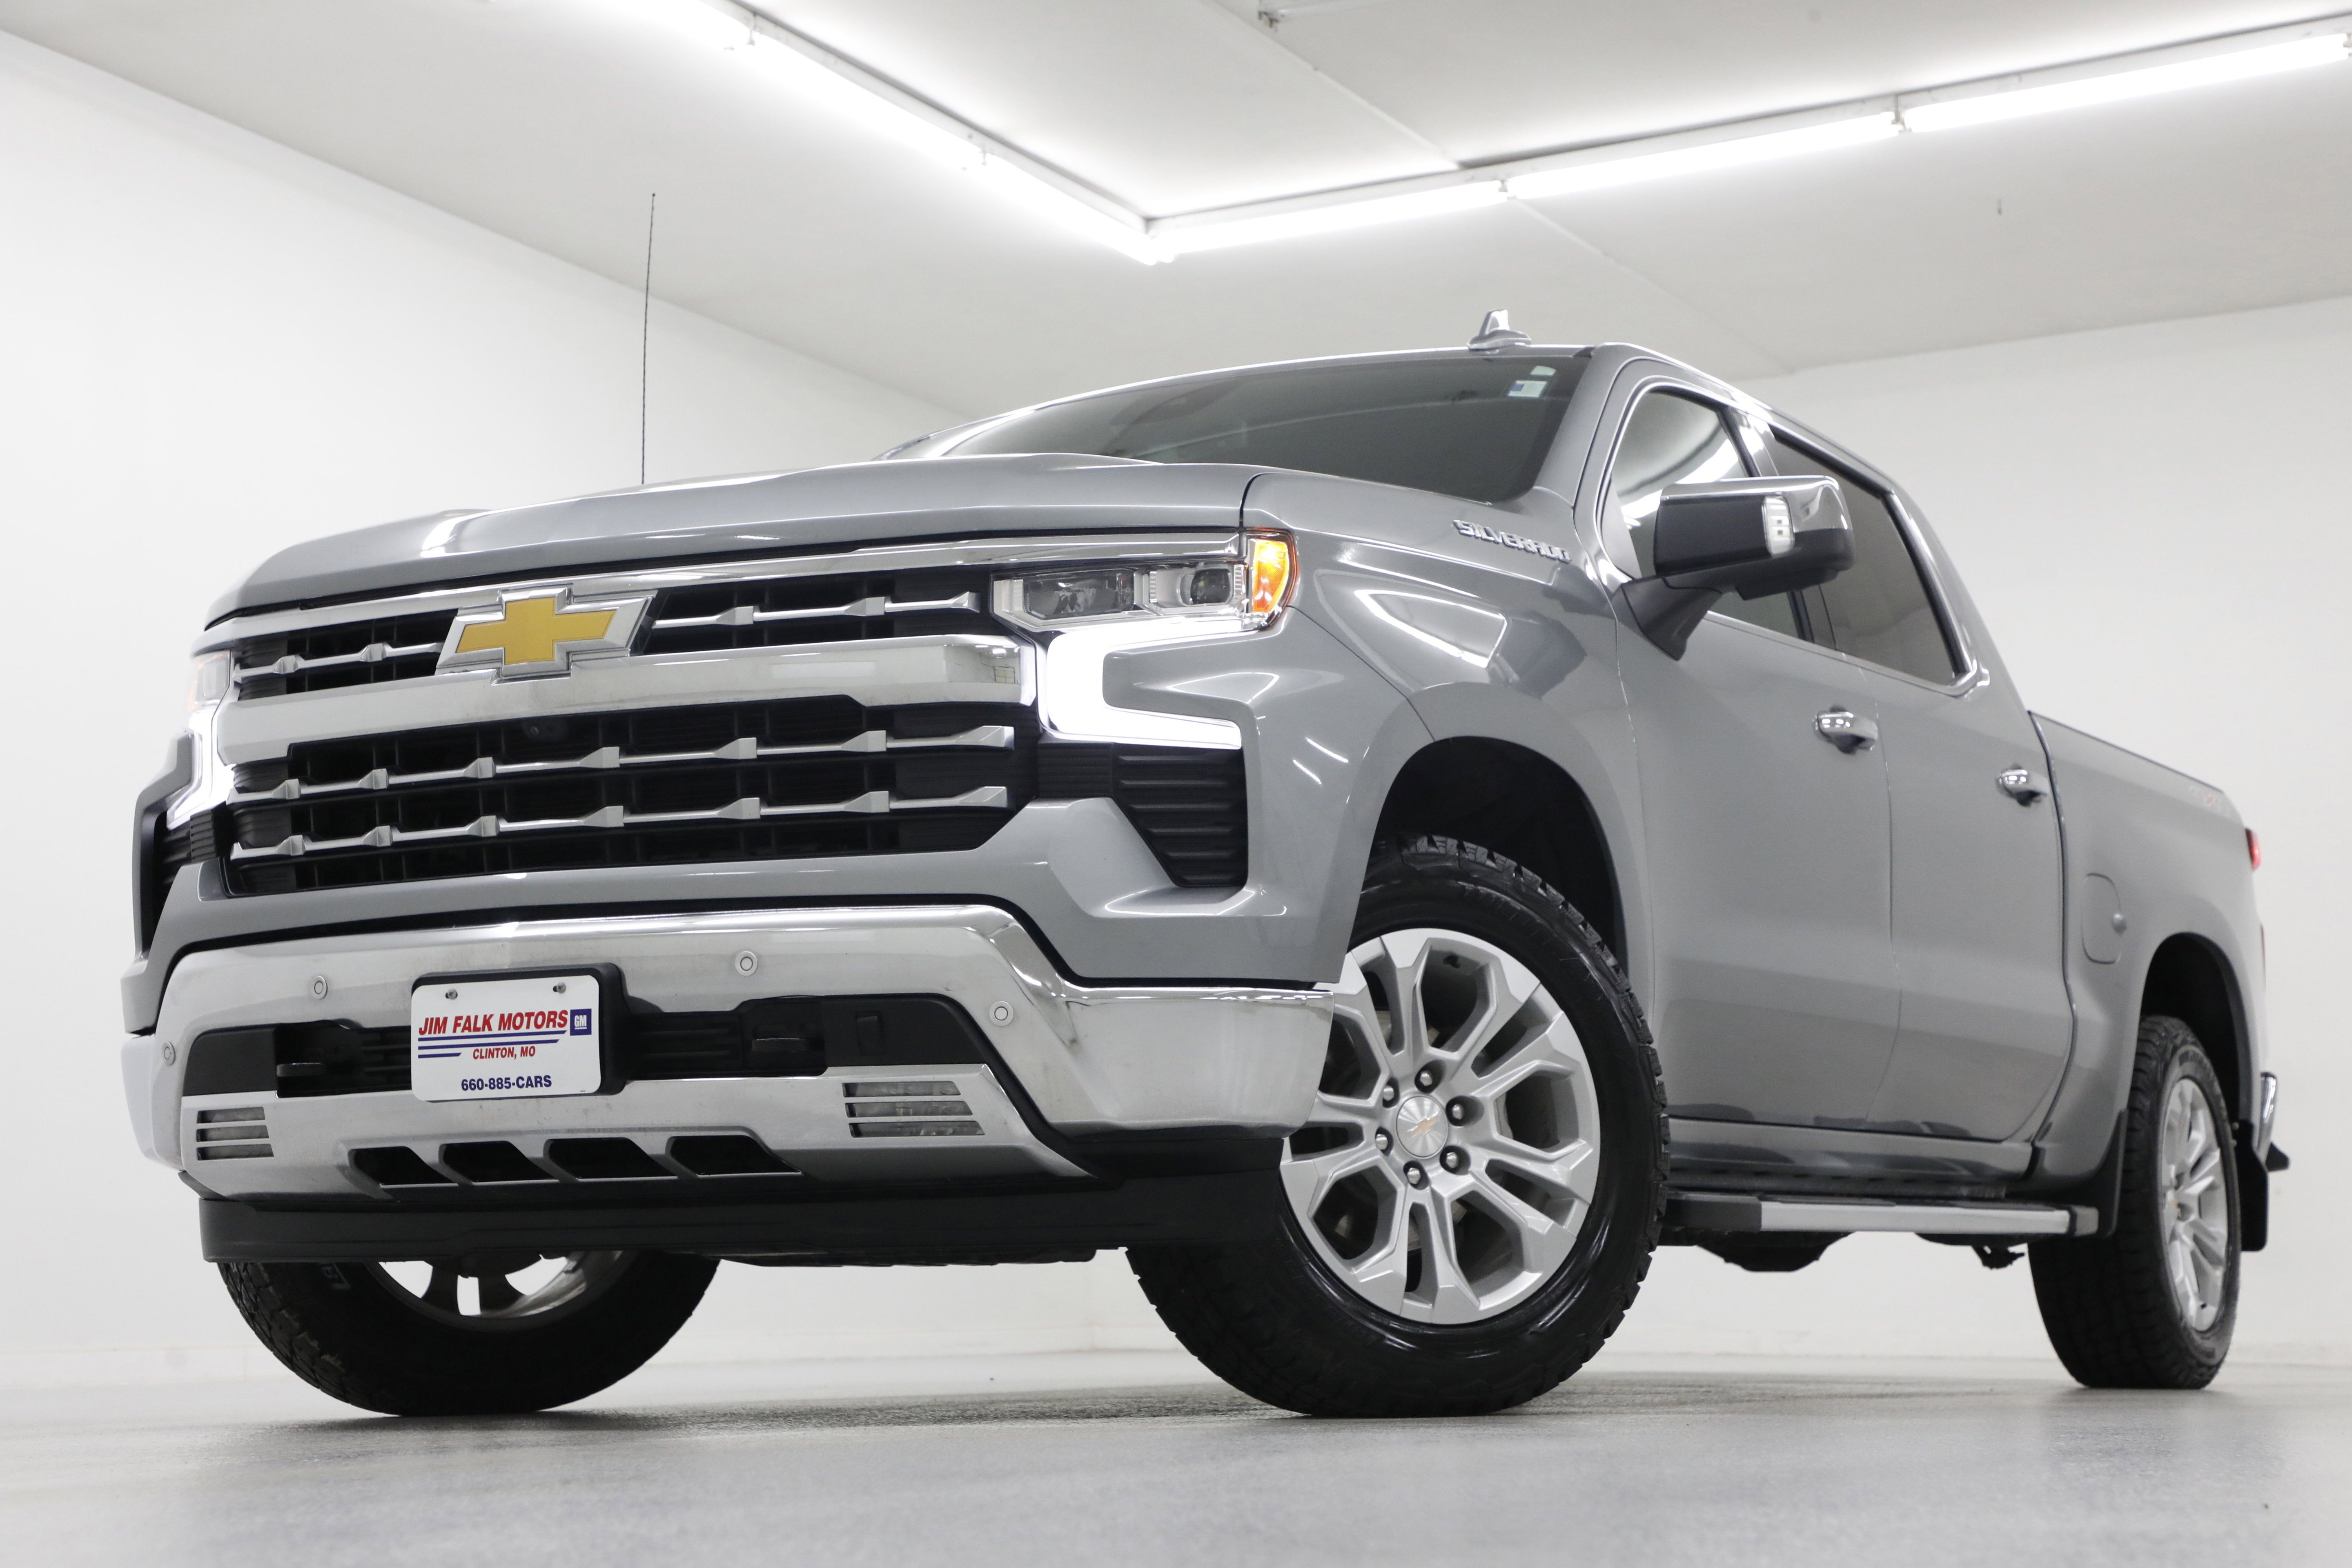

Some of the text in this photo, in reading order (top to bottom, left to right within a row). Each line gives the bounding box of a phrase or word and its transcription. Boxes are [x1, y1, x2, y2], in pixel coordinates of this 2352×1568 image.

[1453, 519, 1571, 563] SILVERADO
[419, 1010, 568, 1036] JIM FALK MOTORS
[574, 1014, 587, 1027] GM
[472, 1046, 536, 1060] CLINTON, MO
[461, 1075, 552, 1091] 660-885-CARS
